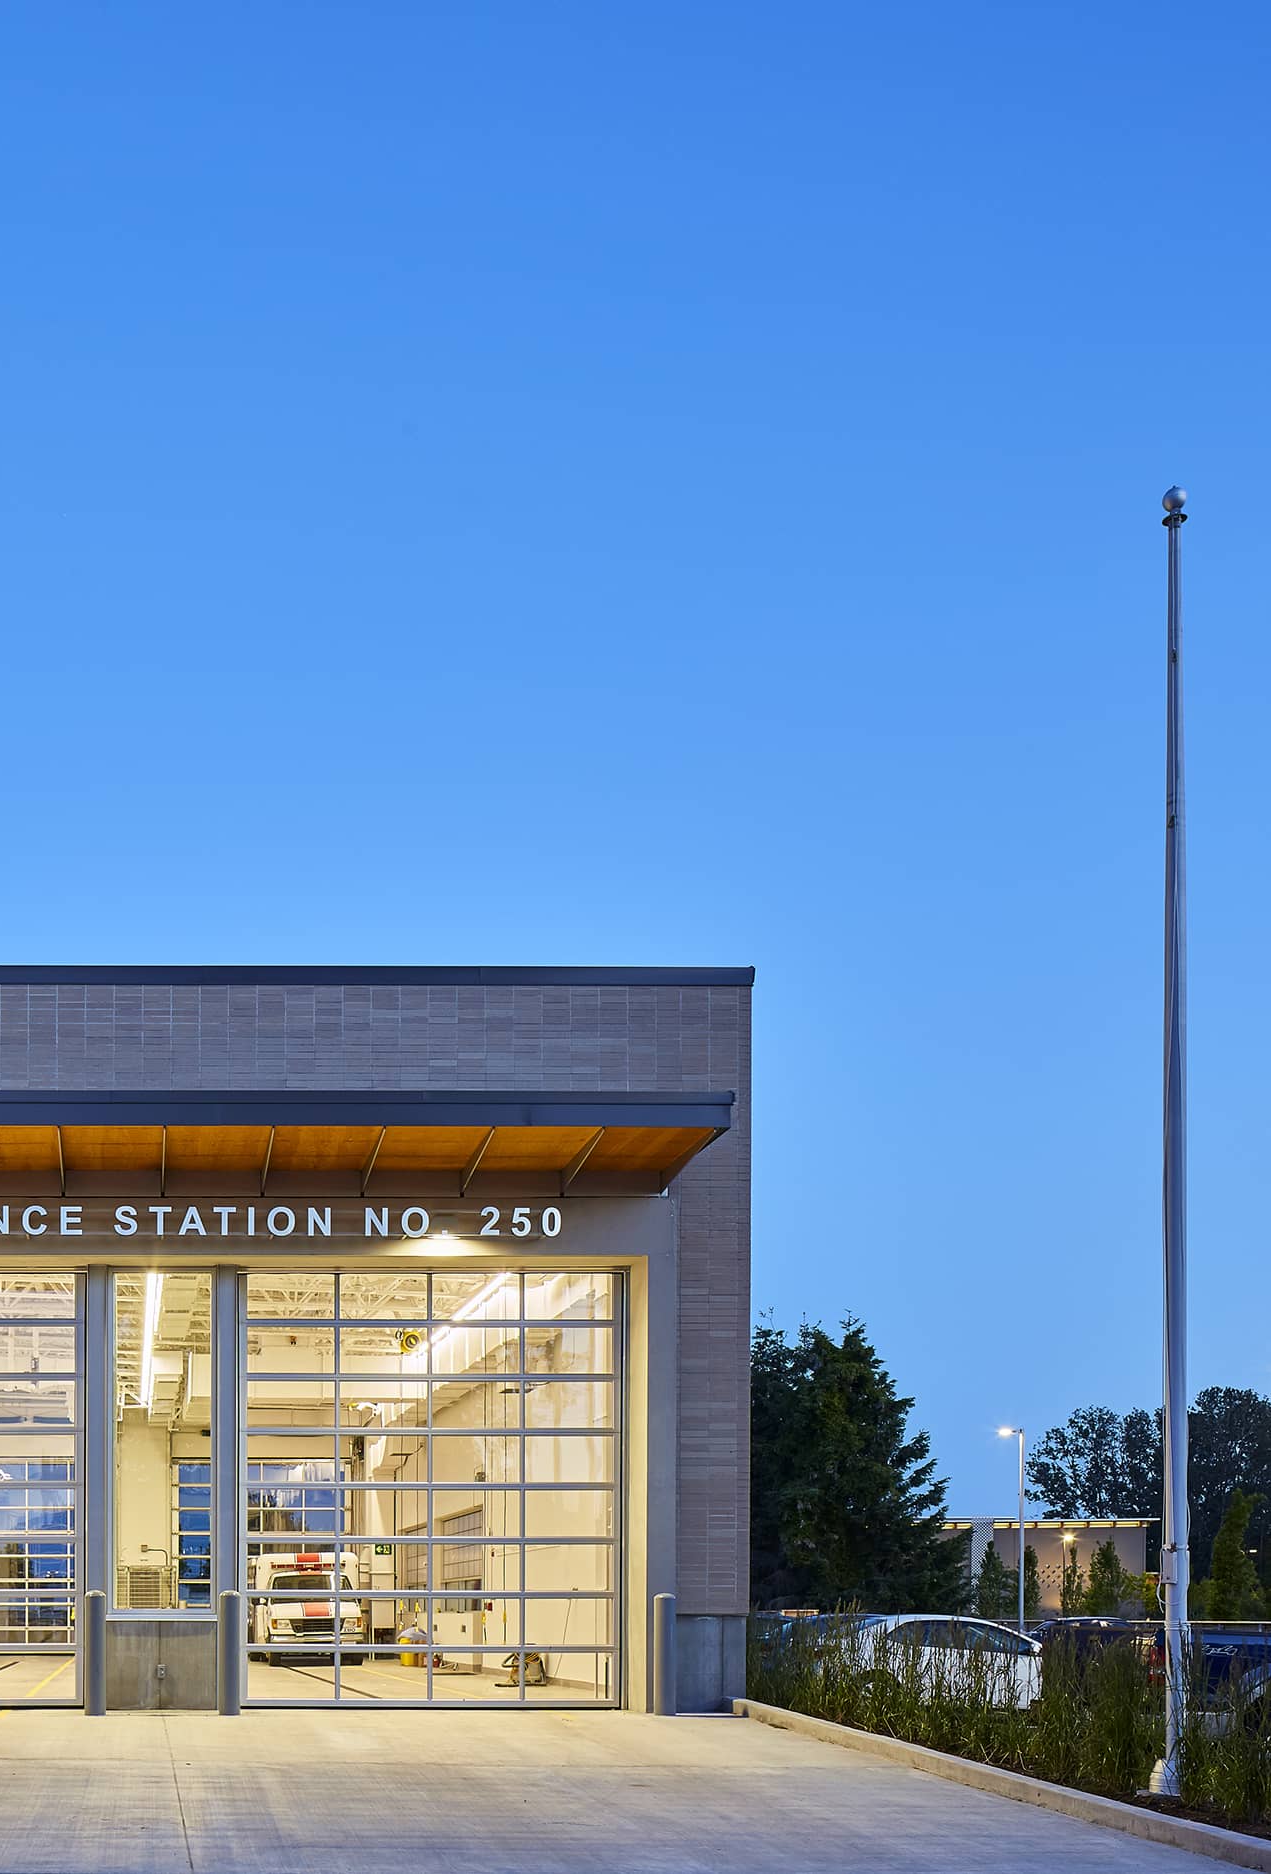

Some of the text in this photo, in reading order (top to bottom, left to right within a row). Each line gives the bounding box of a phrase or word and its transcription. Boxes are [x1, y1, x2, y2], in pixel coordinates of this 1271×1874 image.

[113, 1205, 332, 1237] STATION
[364, 1206, 449, 1238] NO.
[480, 1206, 562, 1237] 250
